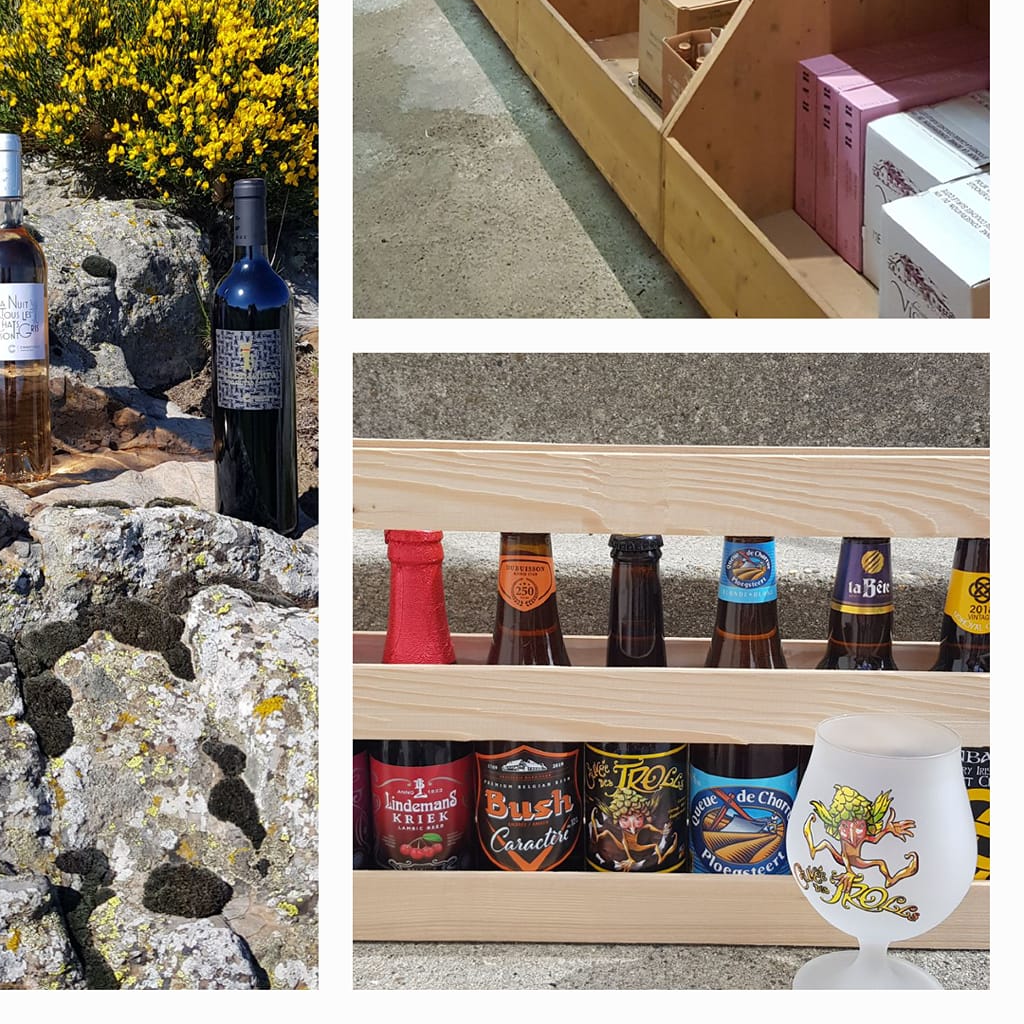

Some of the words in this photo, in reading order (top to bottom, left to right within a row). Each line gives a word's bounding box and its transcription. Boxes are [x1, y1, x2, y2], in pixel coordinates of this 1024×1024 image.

[516, 586, 534, 596] 250
[849, 581, 861, 594] la
[863, 577, 890, 598] Bête
[970, 605, 990, 614] 201
[483, 779, 513, 789] PREMIUM
[485, 789, 574, 821] Bush
[692, 793, 717, 827] Queue
[736, 789, 756, 803] de
[393, 811, 449, 824] KRIEK
[490, 826, 570, 853] Caractère
